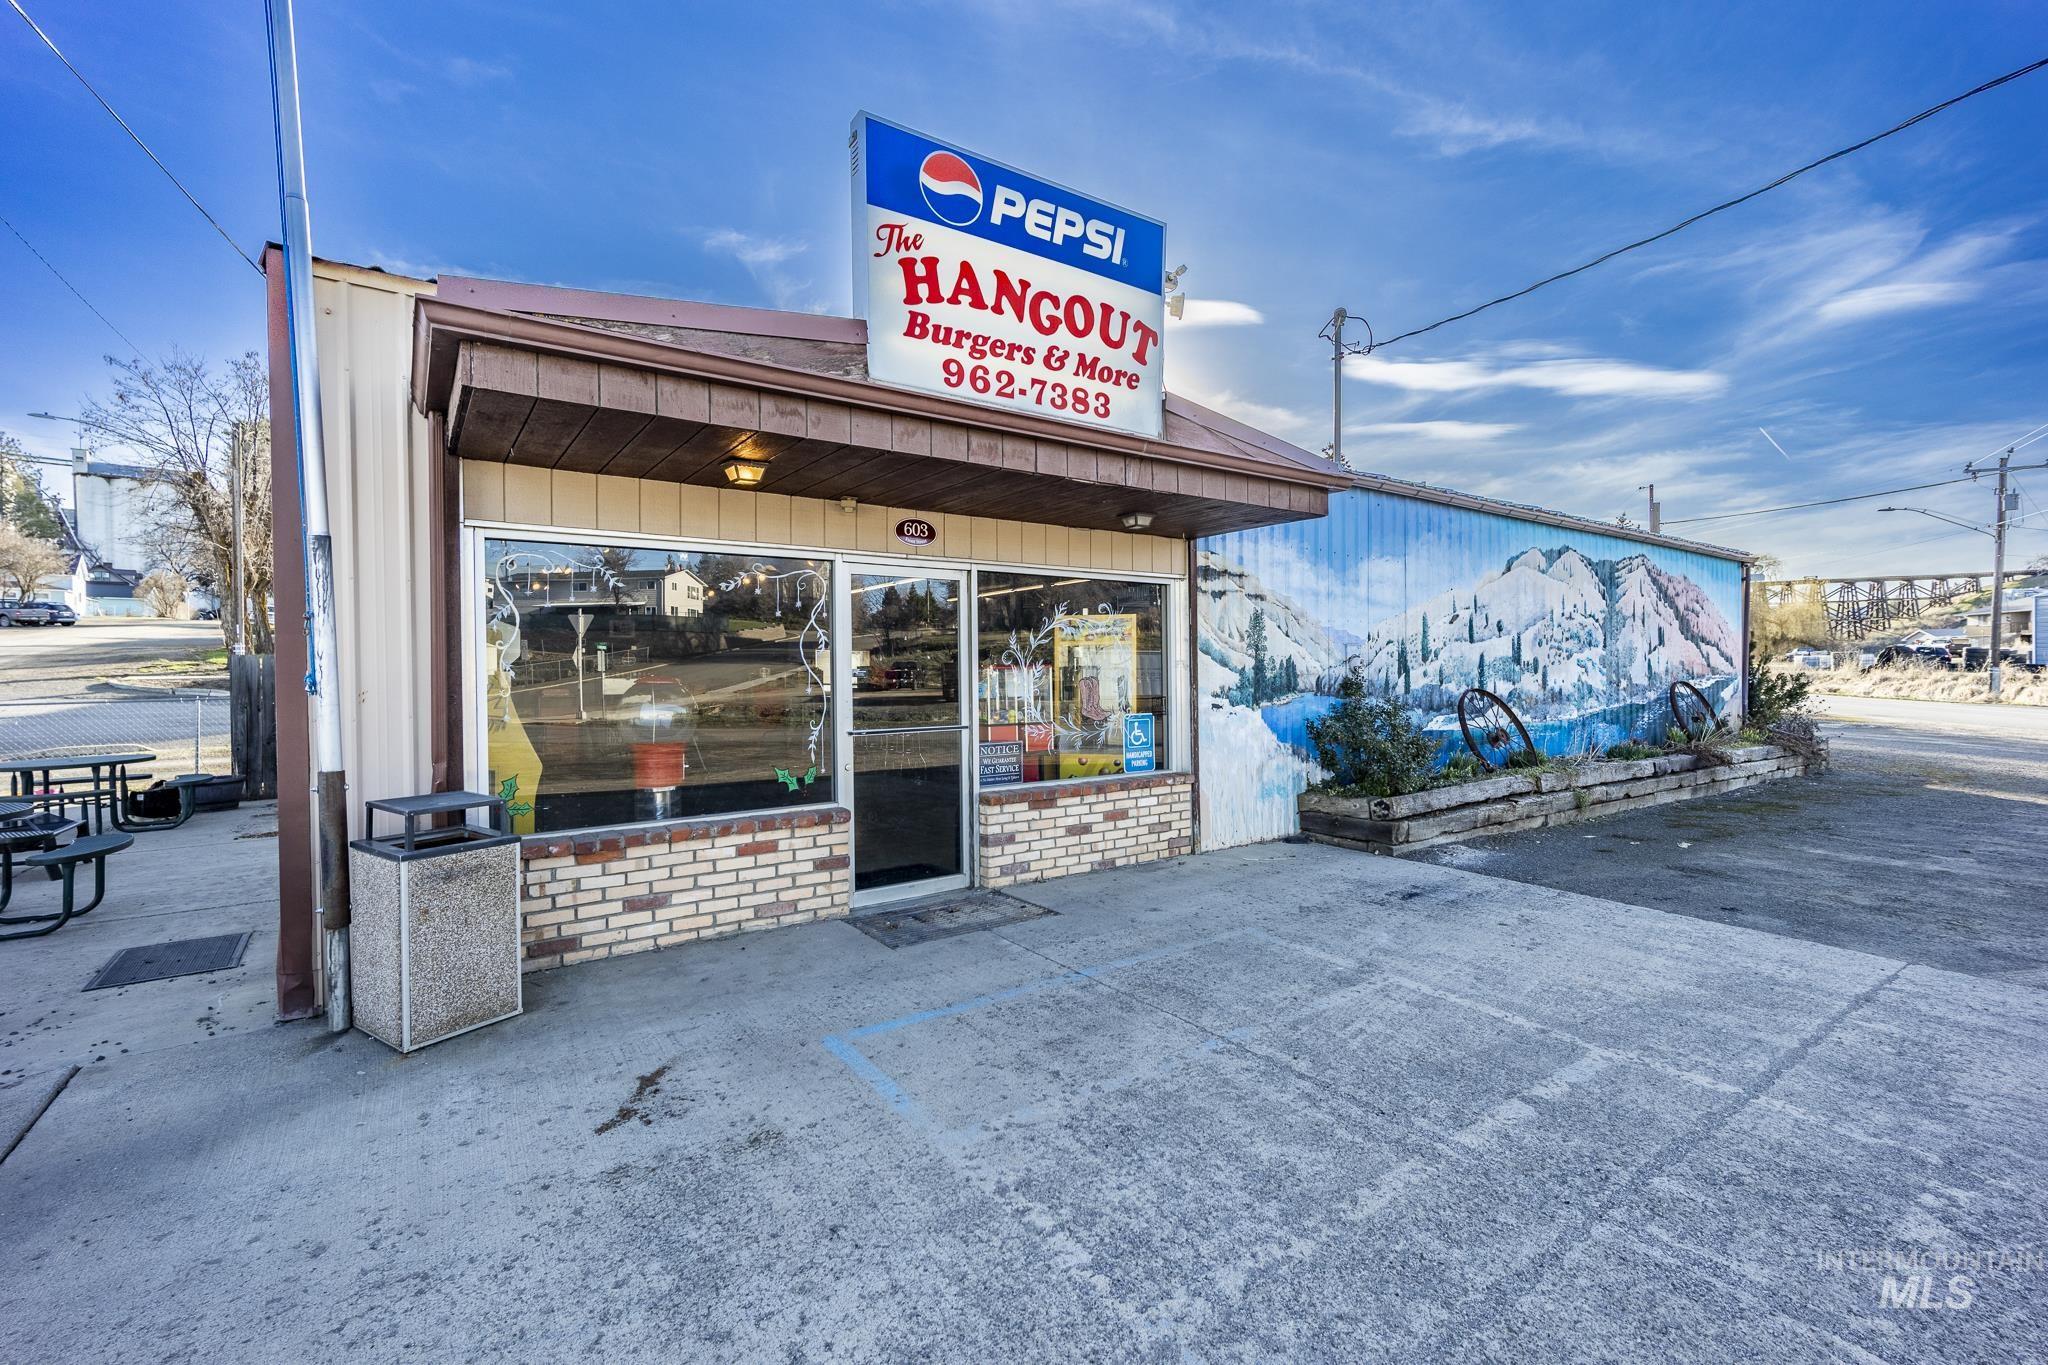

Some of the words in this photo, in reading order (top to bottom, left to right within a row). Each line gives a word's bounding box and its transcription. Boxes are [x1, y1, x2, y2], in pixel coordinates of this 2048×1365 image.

[873, 223, 925, 258] The
[990, 185, 1126, 265] PEPSI
[898, 256, 1159, 366] HANGOUT
[903, 310, 1036, 365] Burgers
[1043, 345, 1069, 372] &
[1073, 352, 1140, 390] More
[942, 358, 1111, 419] 962-7383
[904, 522, 928, 537] 603
[980, 744, 1020, 755] NOTICE
[980, 765, 995, 775] FAST
[995, 764, 1020, 773] SERVICE
